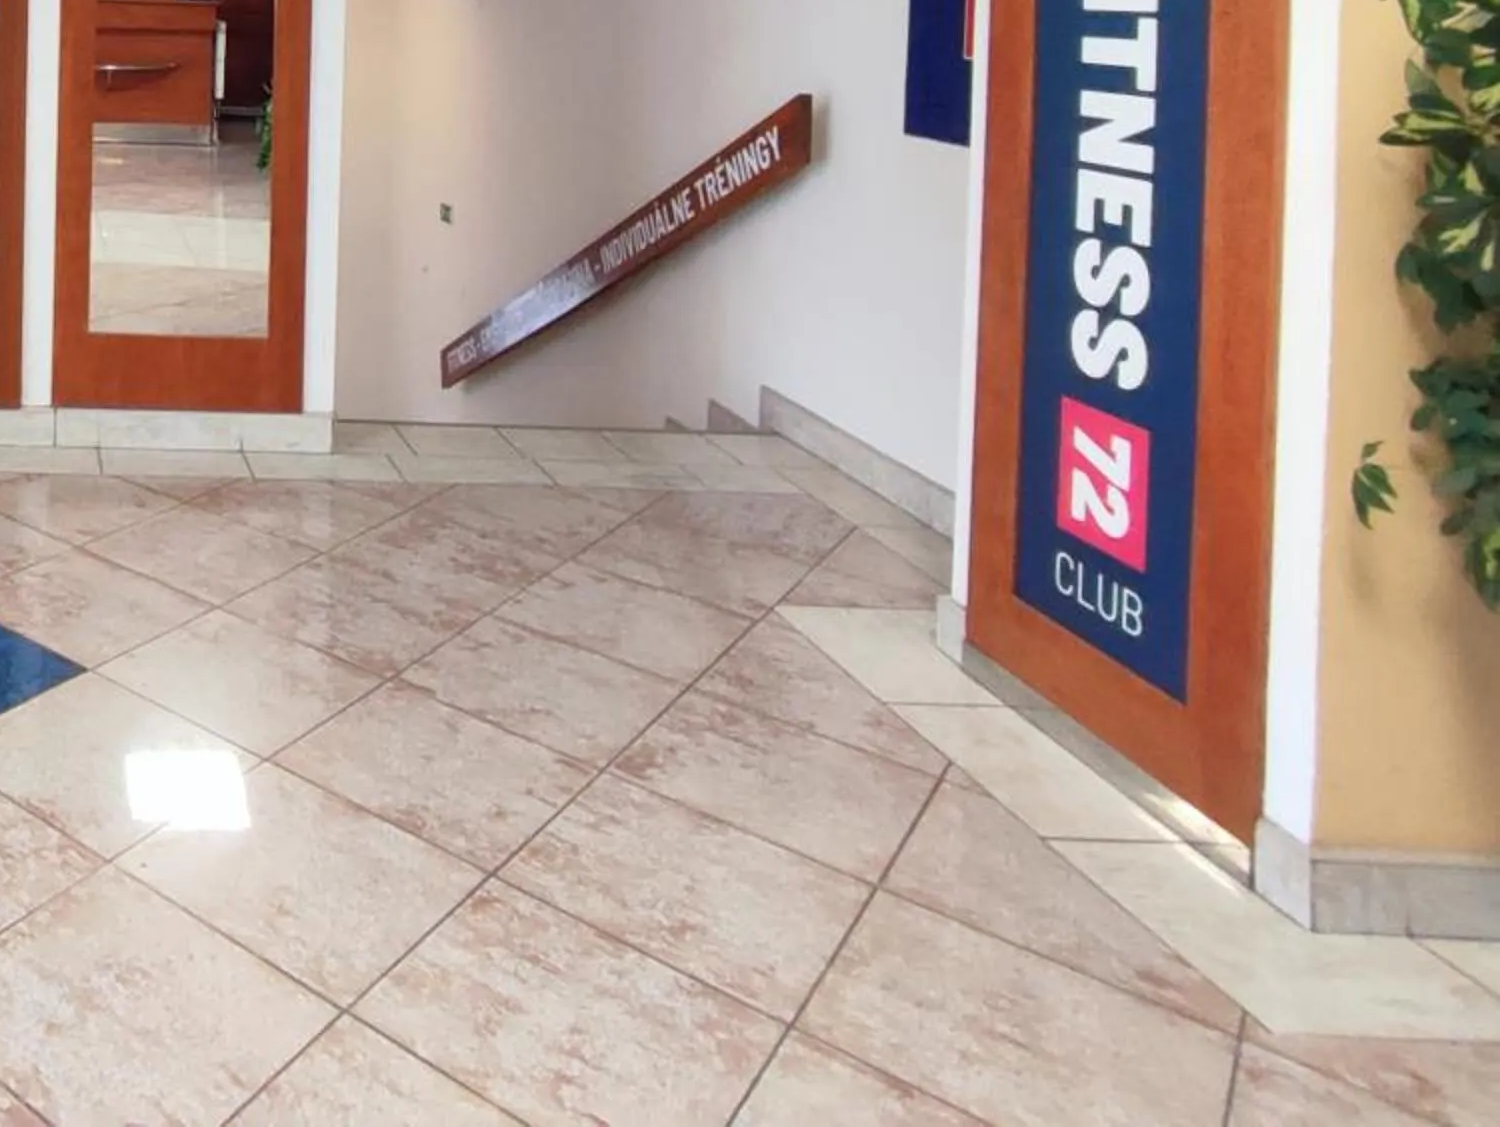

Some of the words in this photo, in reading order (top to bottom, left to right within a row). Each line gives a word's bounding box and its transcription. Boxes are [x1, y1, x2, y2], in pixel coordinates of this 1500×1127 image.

[694, 125, 781, 211] TRÉNINGY
[1070, 424, 1134, 540] 72
[1053, 550, 1144, 638] CLUB
